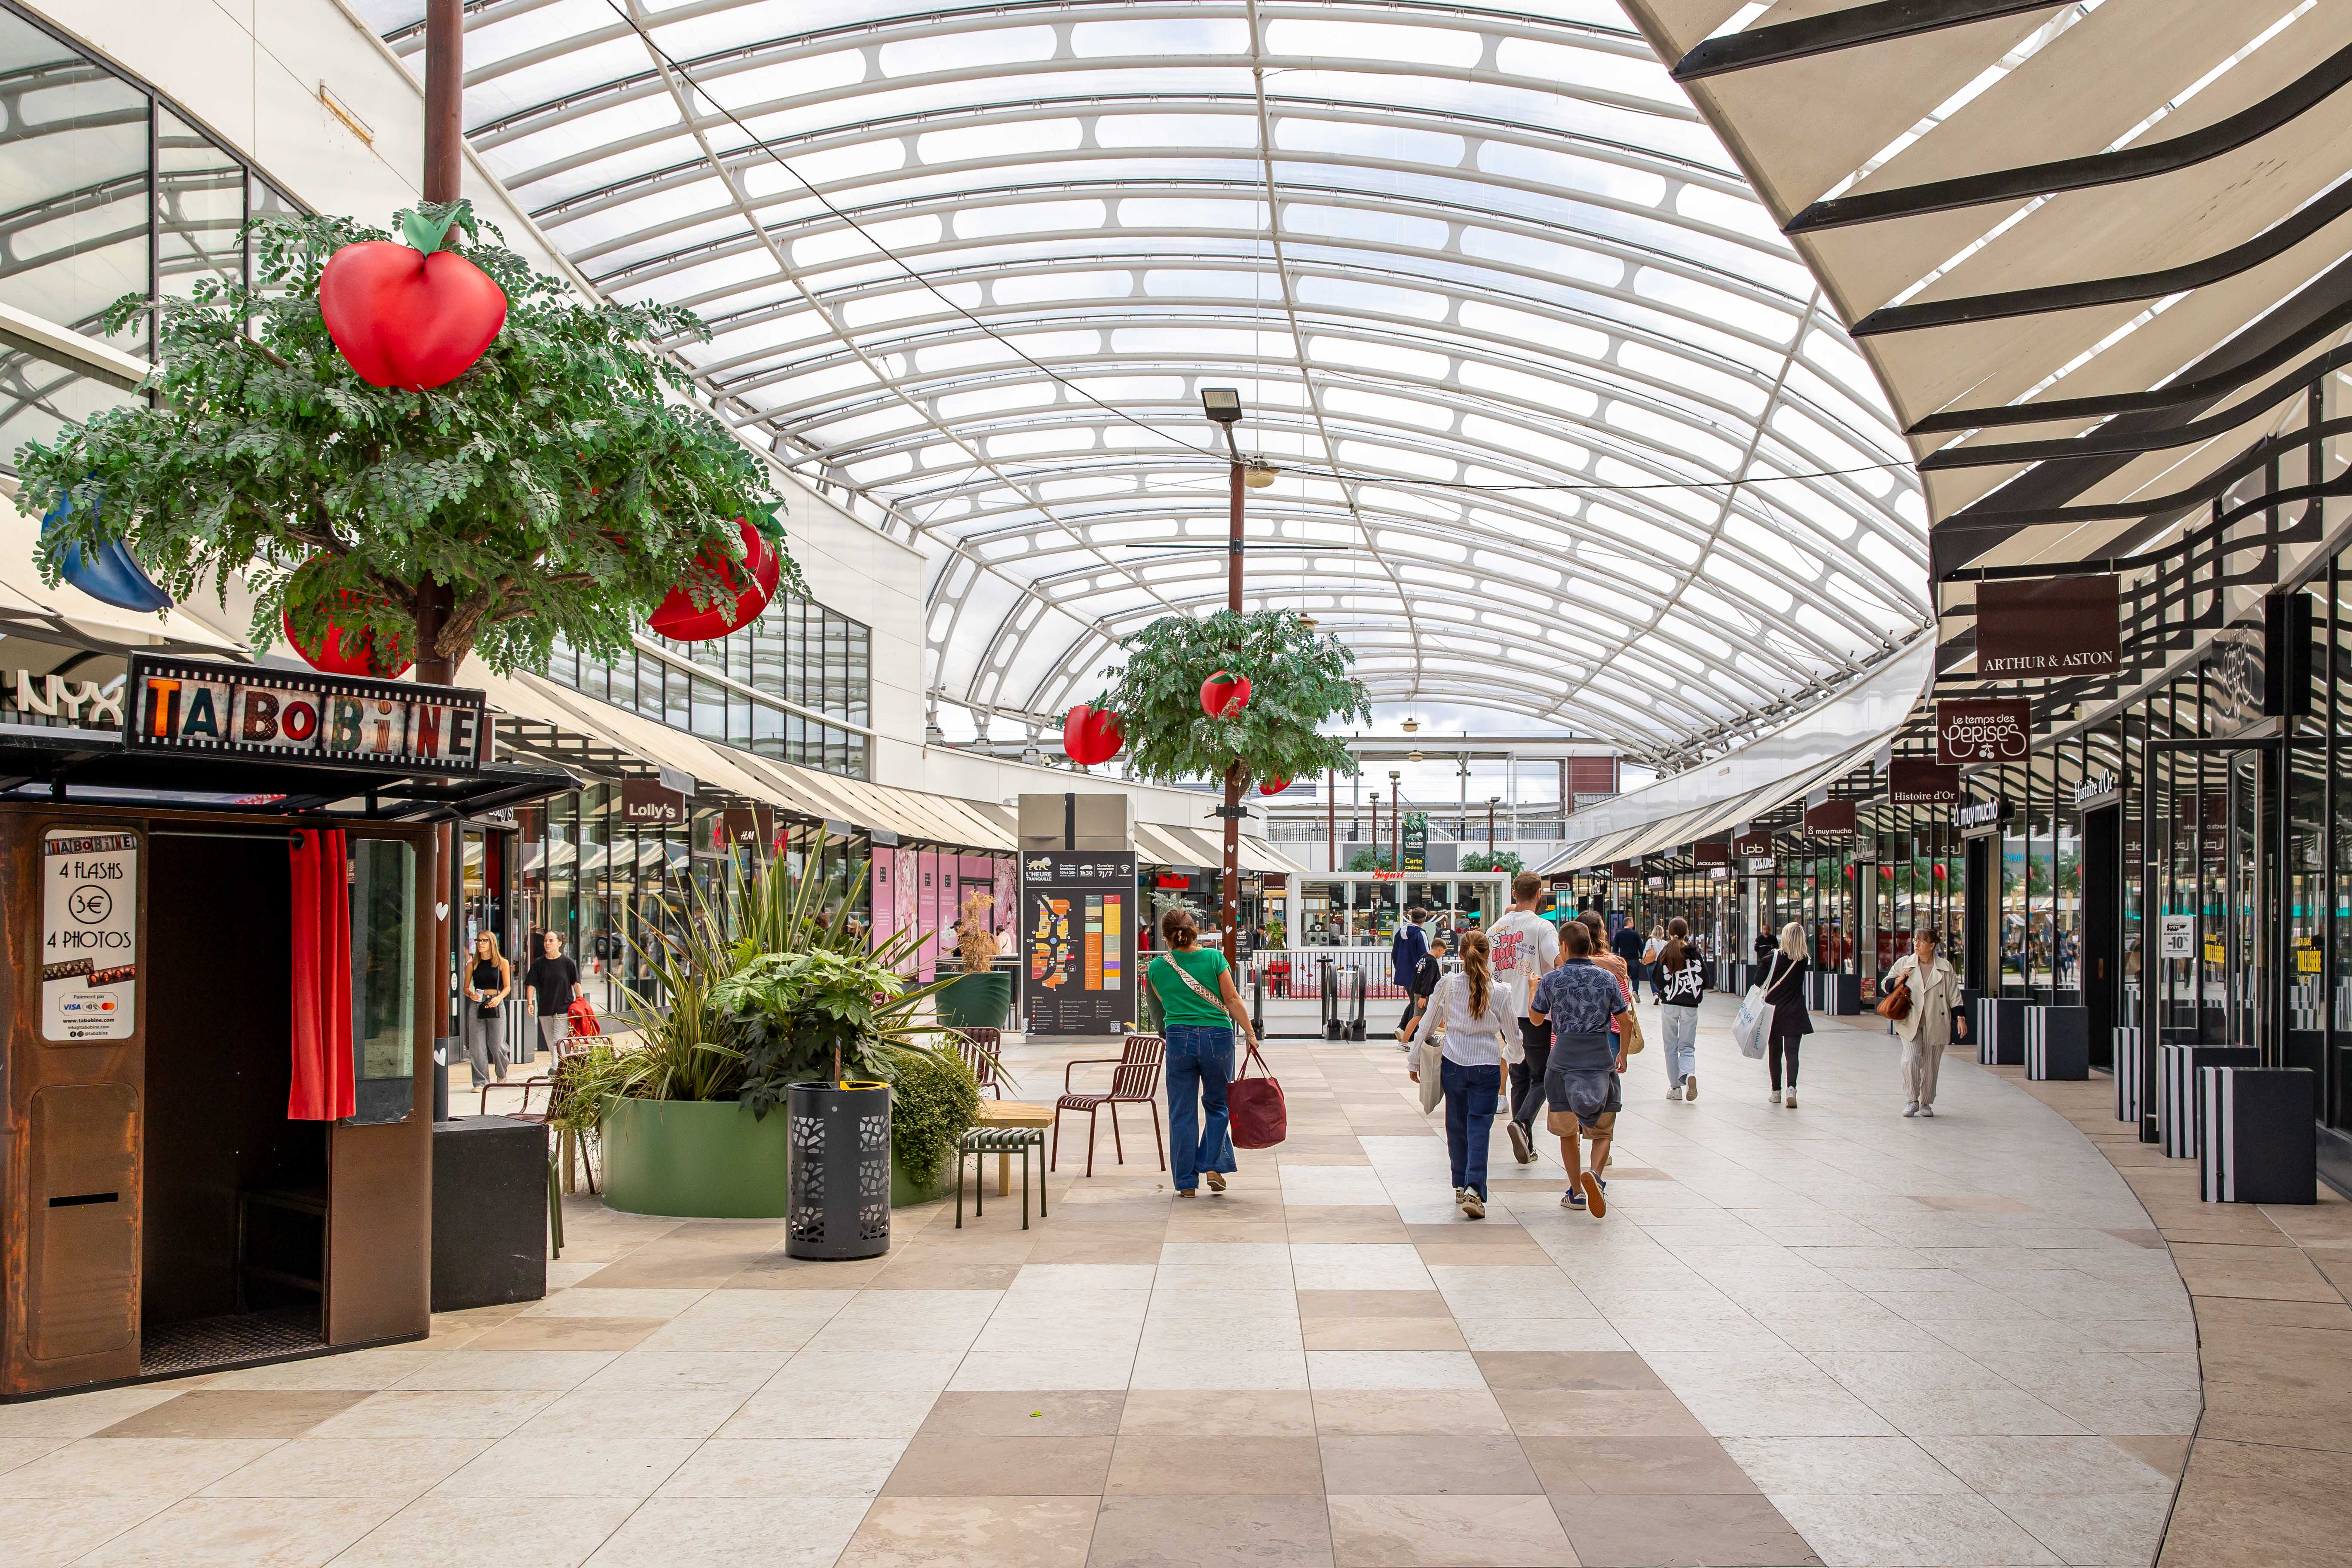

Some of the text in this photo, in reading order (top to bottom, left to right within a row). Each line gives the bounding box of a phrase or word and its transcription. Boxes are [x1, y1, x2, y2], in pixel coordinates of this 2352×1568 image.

[1984, 651, 2113, 671] ARTHUR & ASTON
[1965, 715, 1995, 725] temps
[1997, 714, 2015, 723] des
[2075, 769, 2113, 803] Histoire d'Or
[1895, 791, 1955, 800] Histoire d'Or
[629, 802, 676, 819] Lolly's
[59, 861, 123, 879] 4 FLASHS
[1372, 868, 1406, 882] Yogurt
[76, 895, 104, 914] 3€
[47, 931, 131, 948] 4 PHOTOS
